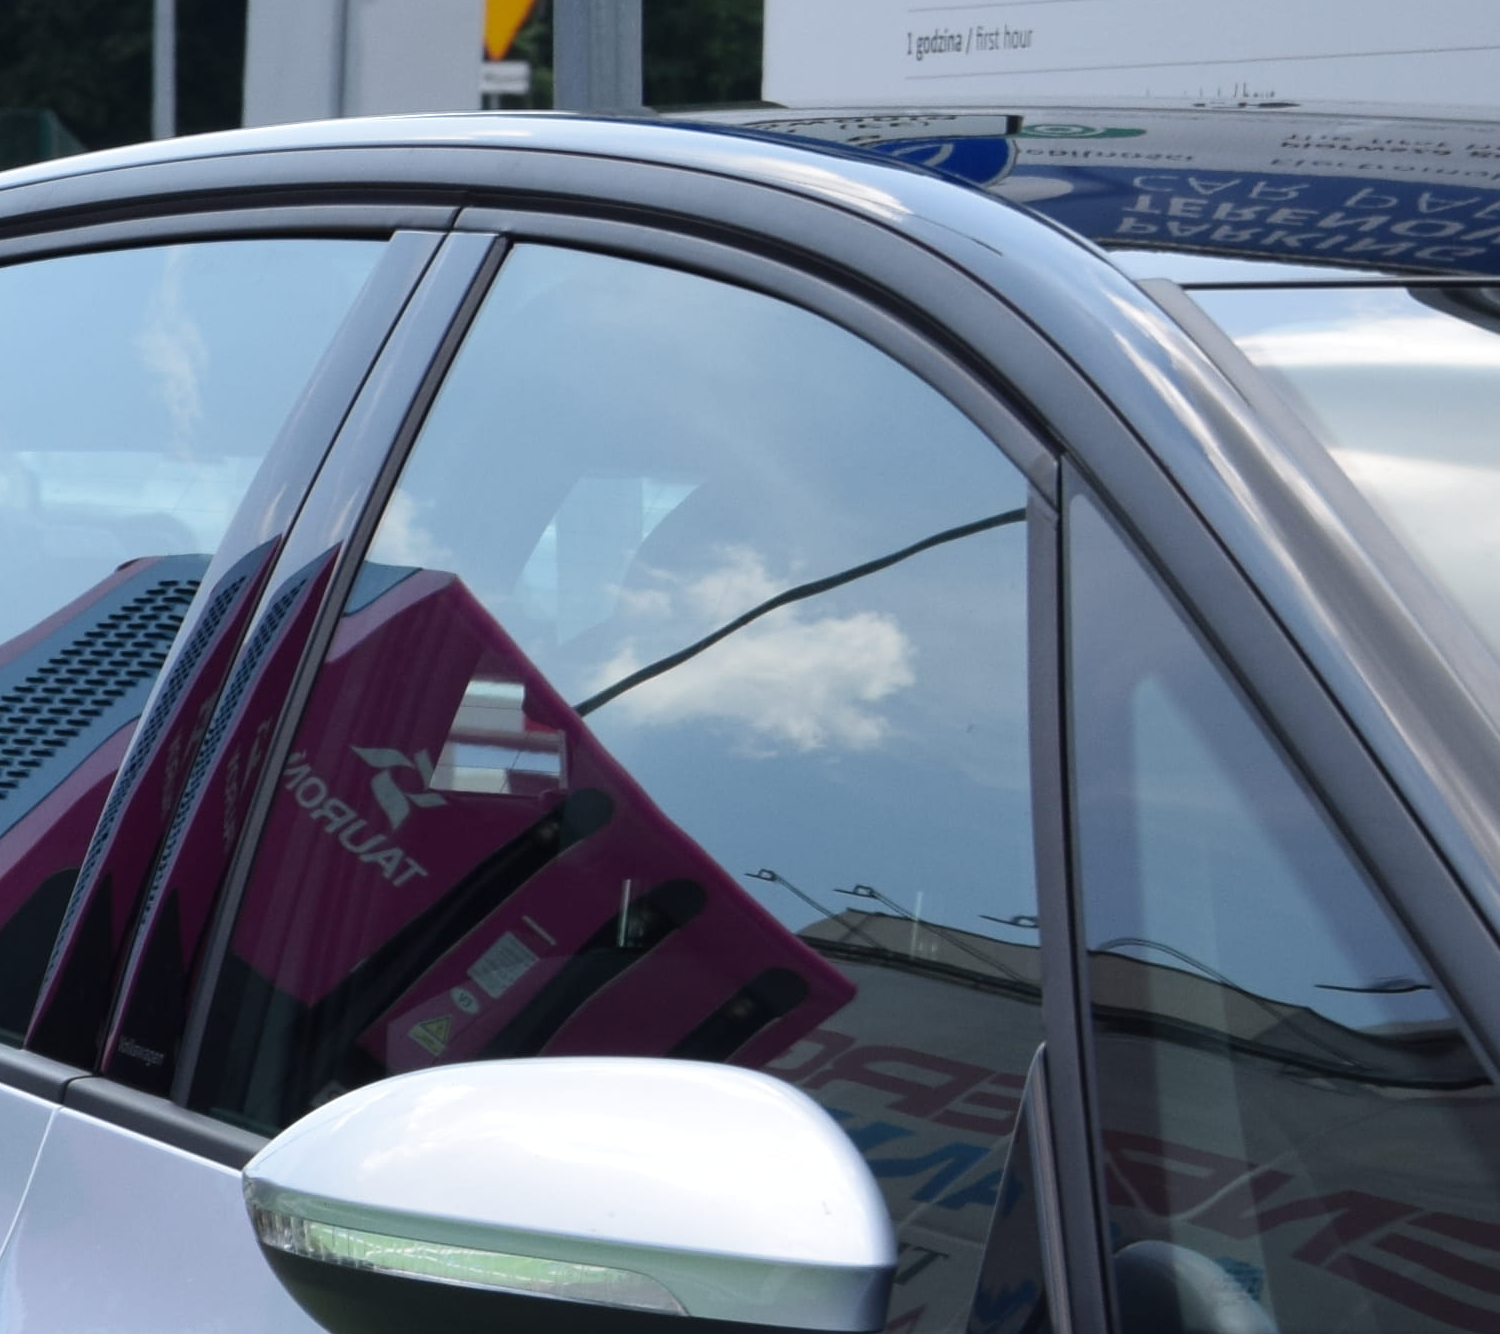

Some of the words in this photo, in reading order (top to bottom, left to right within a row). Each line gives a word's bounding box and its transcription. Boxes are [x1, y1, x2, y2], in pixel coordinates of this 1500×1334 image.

[906, 31, 913, 56] 1
[915, 28, 963, 61] godzina
[974, 25, 1000, 52] first
[1002, 22, 1034, 51] hour
